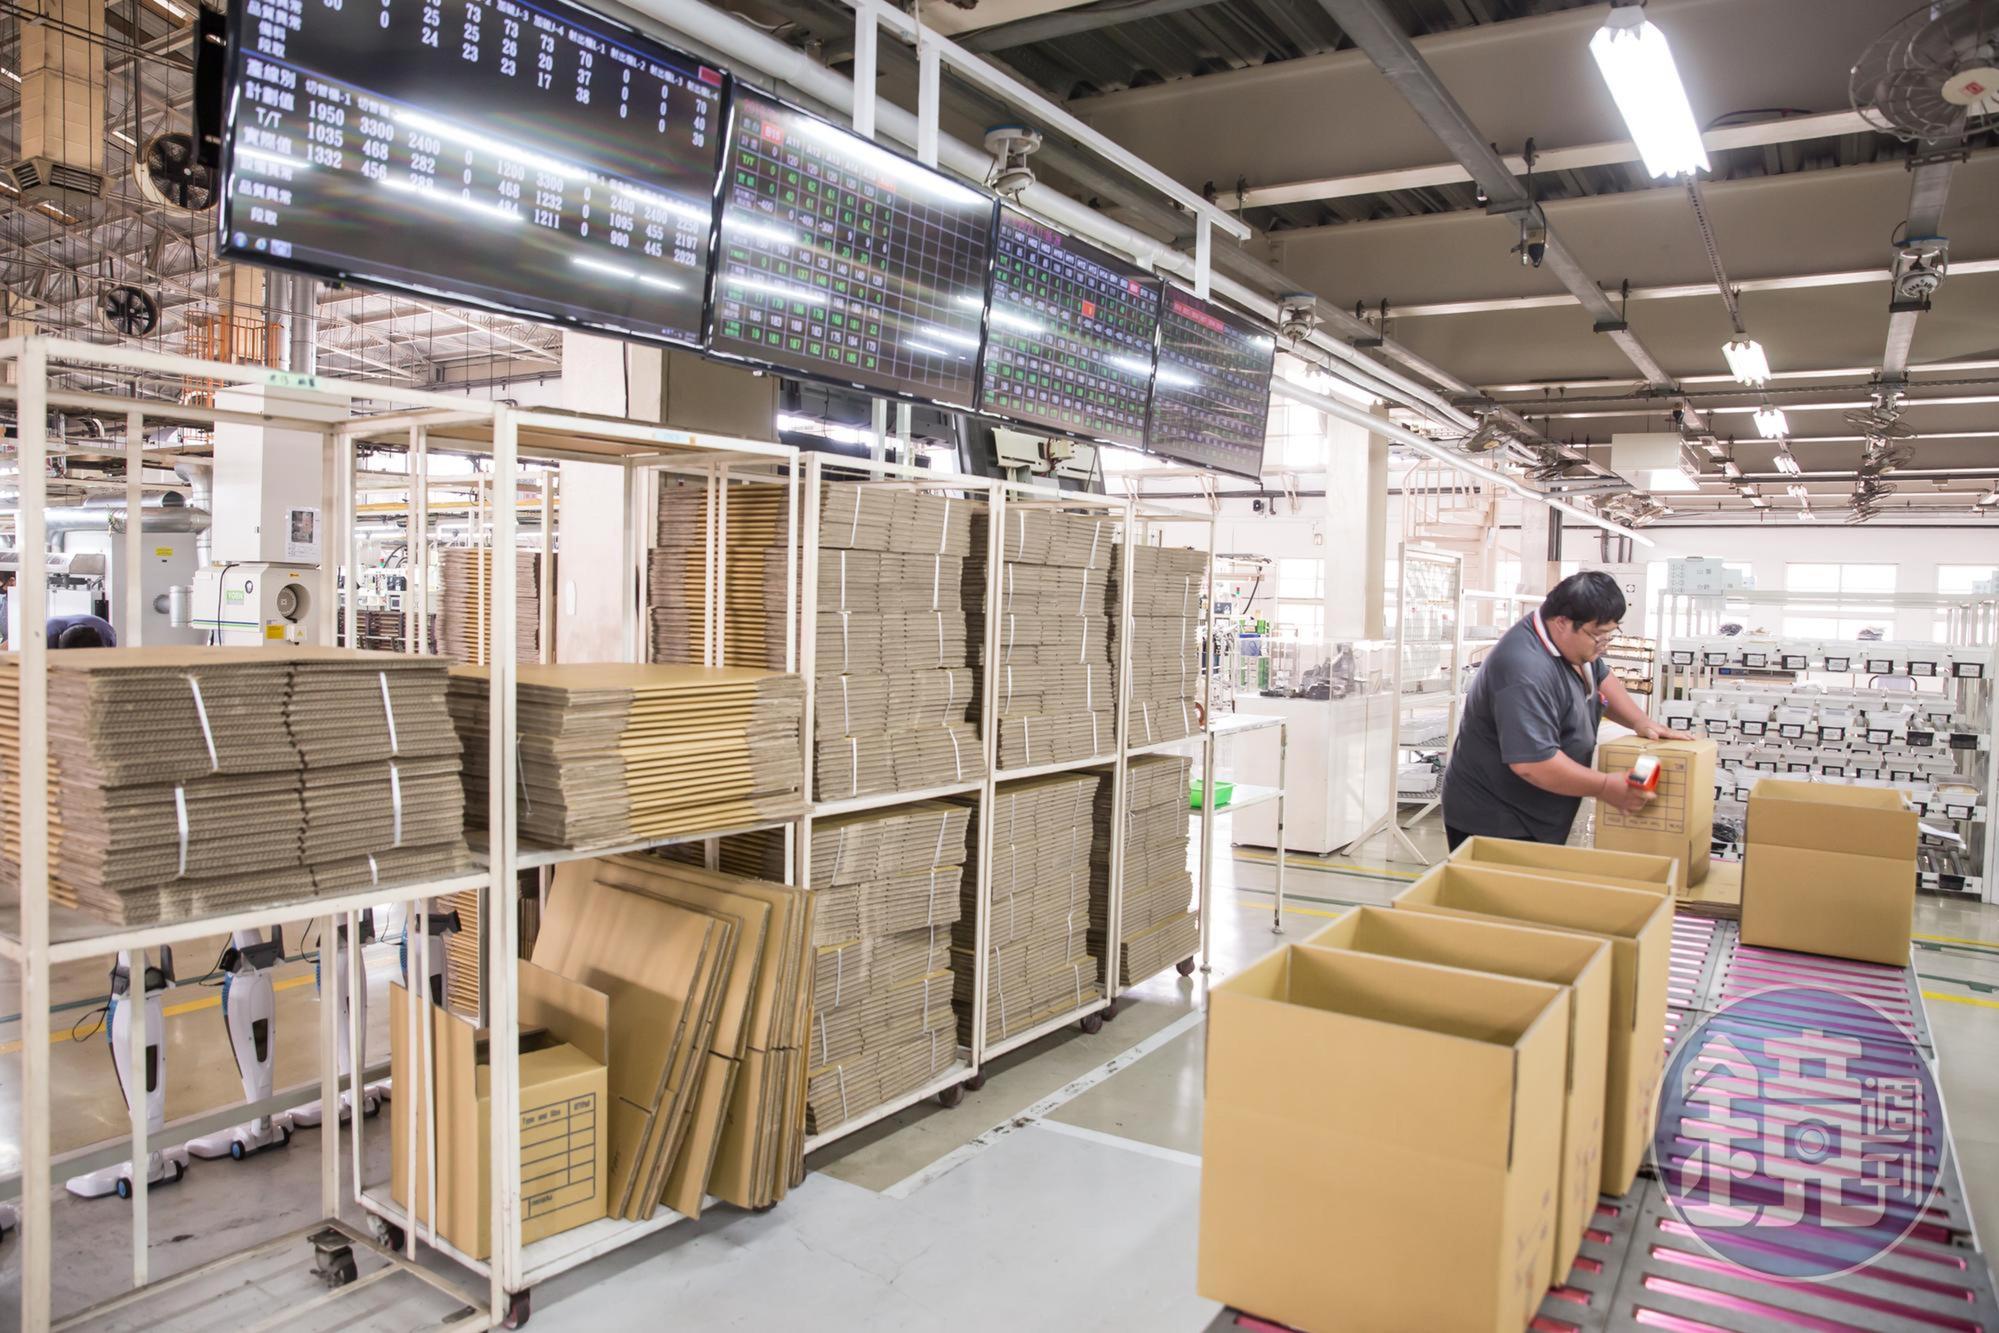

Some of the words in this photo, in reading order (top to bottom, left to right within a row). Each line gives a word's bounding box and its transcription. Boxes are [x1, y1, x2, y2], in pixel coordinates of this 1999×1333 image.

[380, 10, 389, 28] 0
[422, 27, 438, 47] 24
[462, 43, 478, 62] 23
[501, 58, 516, 76] 23
[538, 72, 552, 89] 17
[576, 86, 590, 104] 38
[620, 104, 627, 118] 0
[659, 119, 665, 133] 0
[423, 6, 440, 26] 25
[464, 23, 480, 42] 25
[538, 53, 553, 71] 20
[577, 69, 592, 86] 37
[621, 86, 628, 101] 0
[660, 102, 667, 116] 0
[466, 3, 481, 23] 73
[504, 19, 519, 38] 73
[540, 34, 554, 53] 73
[579, 51, 592, 68] 70
[623, 69, 630, 83] 0
[662, 85, 668, 99] 0
[696, 99, 707, 115] 70
[256, 107, 282, 128] T/T
[307, 122, 343, 147] 1035
[362, 140, 388, 160] 468
[410, 153, 435, 174] 282
[464, 169, 471, 184] 0
[499, 180, 520, 199] 468
[536, 190, 562, 211] 1232
[582, 205, 589, 218] 0
[610, 213, 633, 231] 1095
[646, 224, 663, 240] 455
[306, 144, 342, 168] 1332
[361, 160, 387, 180] 456
[534, 208, 559, 229] 1211
[581, 223, 588, 237] 0
[610, 231, 629, 248] 990
[644, 241, 662, 257] 445
[309, 100, 344, 126] 1950
[360, 116, 394, 141] 3300
[408, 132, 440, 155] 2400
[465, 150, 472, 165] 0
[497, 160, 525, 181] 1200
[536, 171, 563, 192] 3300
[584, 187, 591, 200] 0
[610, 195, 635, 214] 2400
[644, 206, 667, 224] 2400
